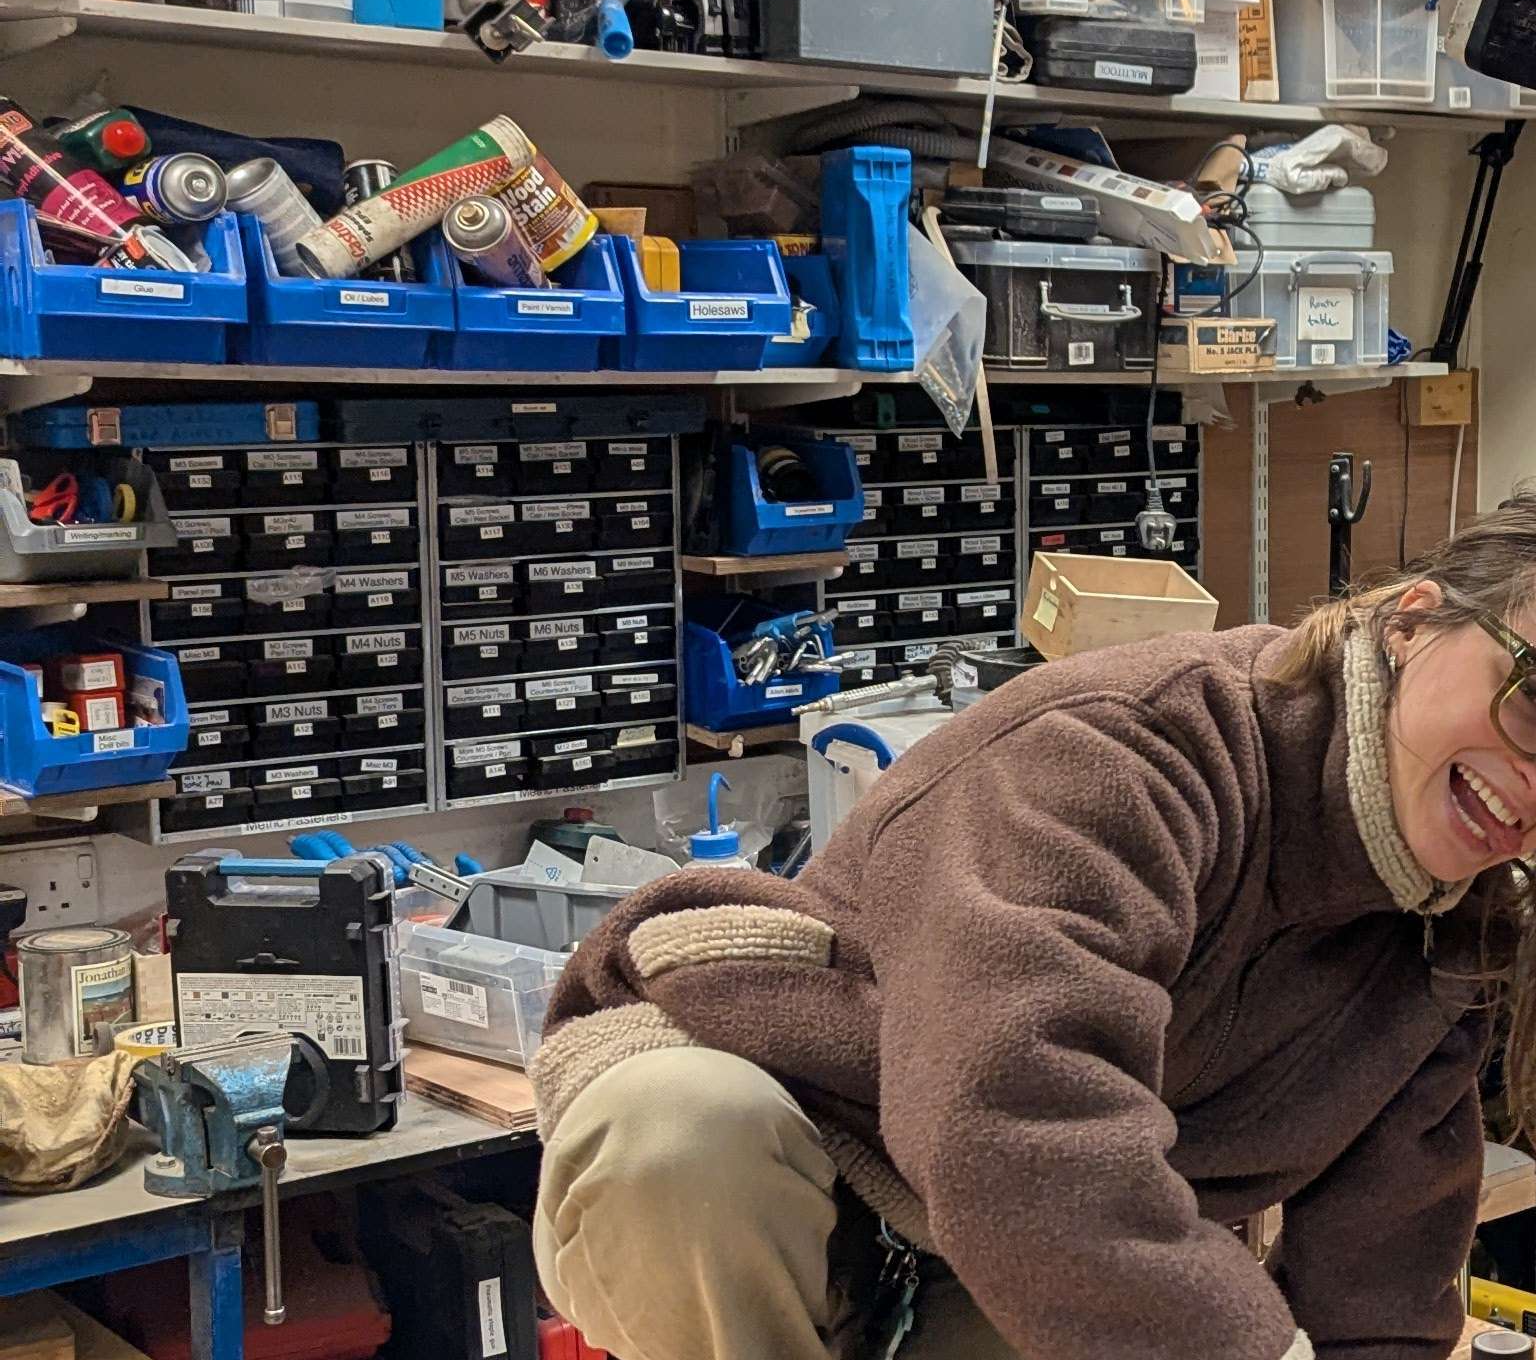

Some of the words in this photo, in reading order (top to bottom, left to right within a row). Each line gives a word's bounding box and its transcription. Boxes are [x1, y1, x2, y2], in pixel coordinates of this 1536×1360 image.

[1099, 63, 1149, 81] MULTITOOL
[502, 165, 545, 207] Wood
[512, 185, 557, 227] Stain
[134, 285, 154, 294] Glue
[344, 293, 356, 301] Oil
[362, 294, 385, 304] Lubes
[521, 302, 540, 311] Paint
[545, 302, 571, 312] Varnish
[692, 303, 746, 316] Holesaws
[1217, 326, 1257, 343] Clarke
[1227, 347, 1244, 355] JACK
[451, 573, 466, 582] M5
[468, 570, 510, 580] Washers
[533, 566, 549, 576] M6
[551, 565, 592, 575] Washers
[340, 578, 358, 589] M4
[360, 576, 405, 588] Washers
[535, 624, 551, 634] M6
[555, 622, 580, 633] Nuts
[459, 630, 476, 641] M5
[480, 628, 506, 639] Nuts
[351, 638, 369, 649] M4
[373, 637, 401, 648] Nuts
[271, 708, 290, 719] M3
[294, 706, 323, 718] Nuts
[99, 741, 117, 749] Drill
[459, 748, 475, 756] More
[486, 745, 508, 753] Screws
[79, 967, 126, 984] Jonathan
